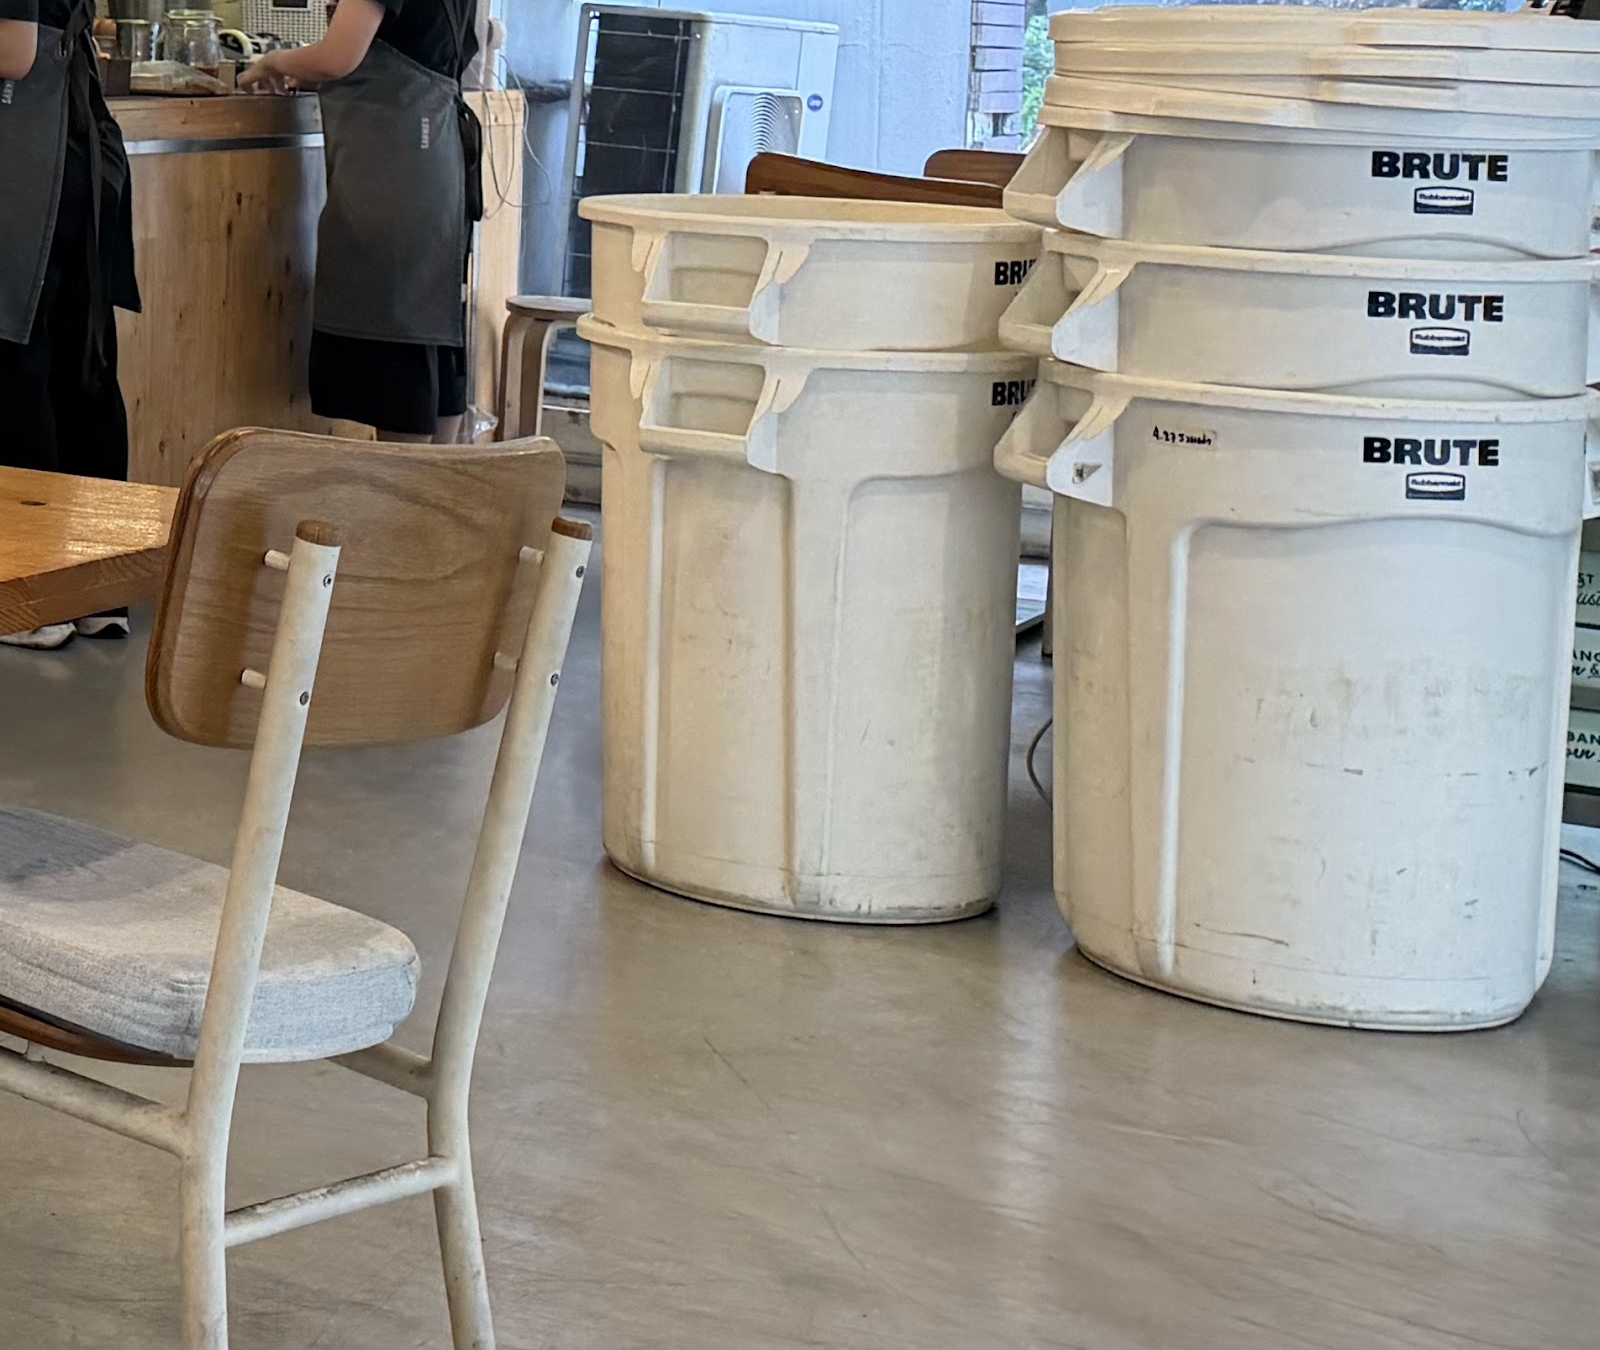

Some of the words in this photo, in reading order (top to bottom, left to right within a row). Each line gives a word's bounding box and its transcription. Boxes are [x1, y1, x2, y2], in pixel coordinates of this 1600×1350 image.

[1371, 150, 1509, 182] BRUTE
[1367, 290, 1504, 323] BRUTE
[1363, 436, 1500, 467] BRUTE
